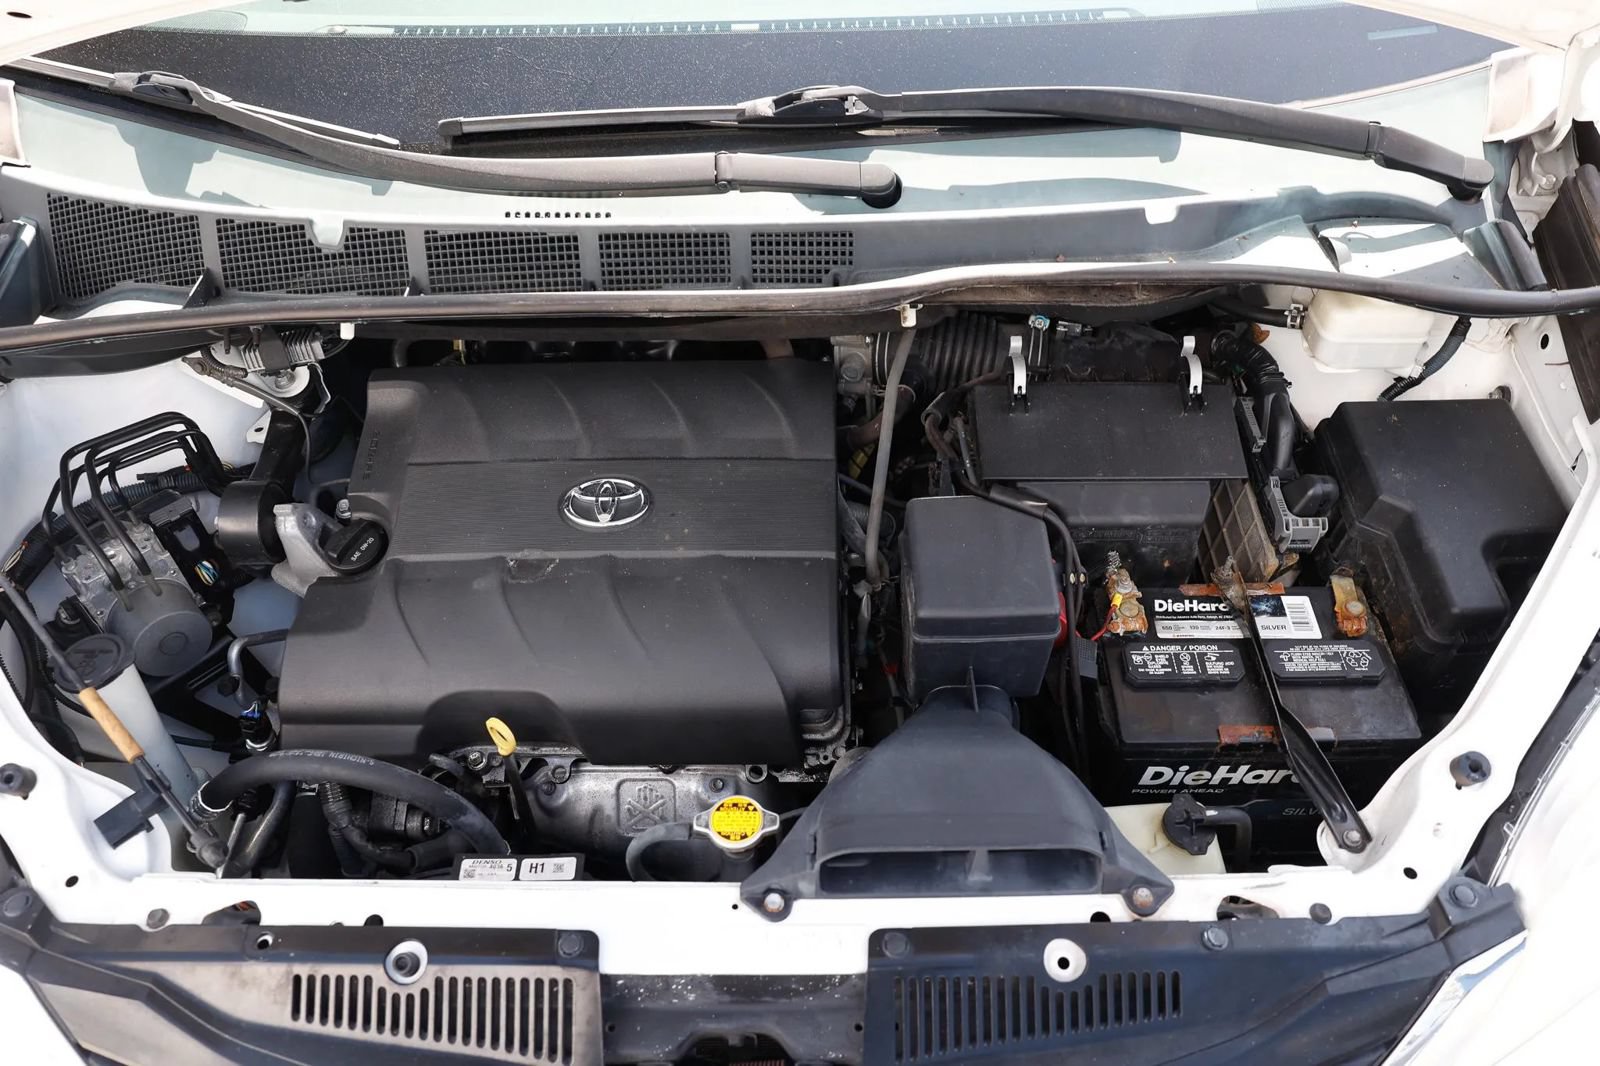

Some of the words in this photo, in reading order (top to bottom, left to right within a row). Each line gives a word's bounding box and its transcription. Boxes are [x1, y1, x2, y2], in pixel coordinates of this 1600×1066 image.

[350, 551, 362, 562] SAE
[360, 537, 375, 551] 0W-20
[1138, 764, 1300, 786] DieHar
[506, 864, 513, 872] 5
[529, 862, 545, 874] H1
